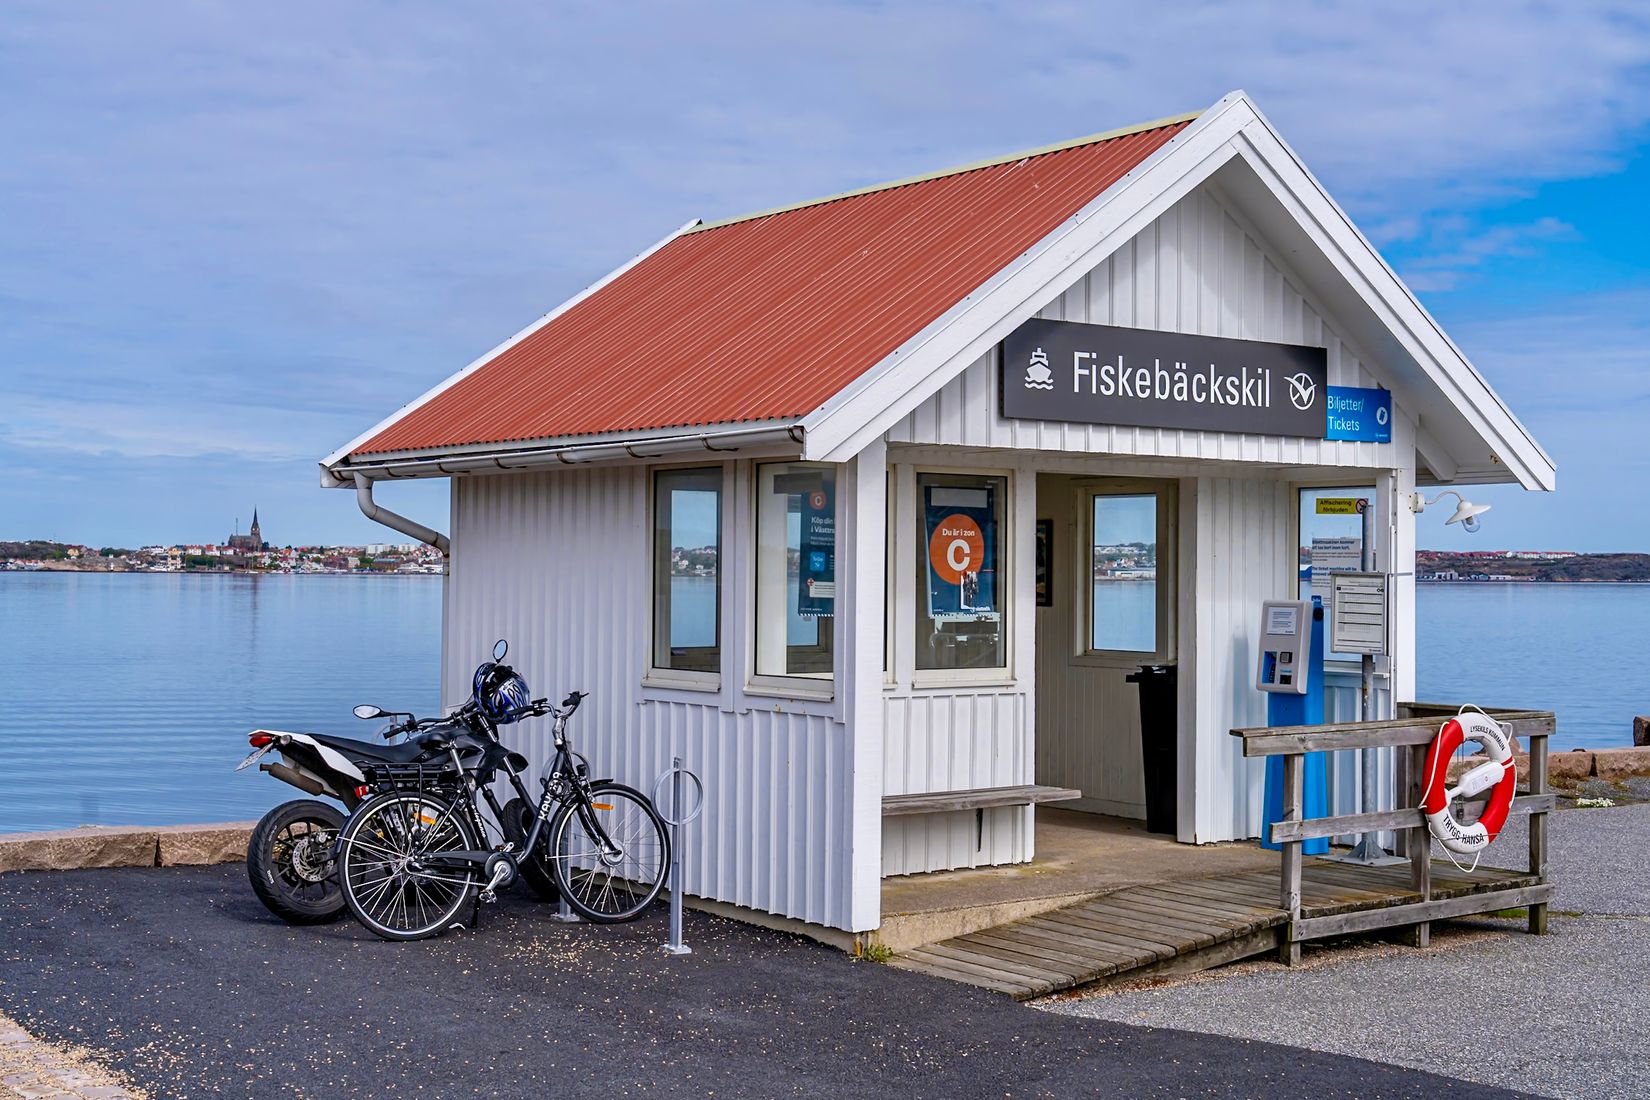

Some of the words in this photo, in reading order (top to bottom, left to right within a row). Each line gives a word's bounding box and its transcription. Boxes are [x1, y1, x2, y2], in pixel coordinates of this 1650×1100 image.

[1073, 351, 1270, 408] Fiskebäckskil
[1327, 395, 1365, 413] Biljetter/
[1327, 416, 1360, 431] Tickets
[942, 528, 952, 536] Du
[947, 539, 970, 571] C
